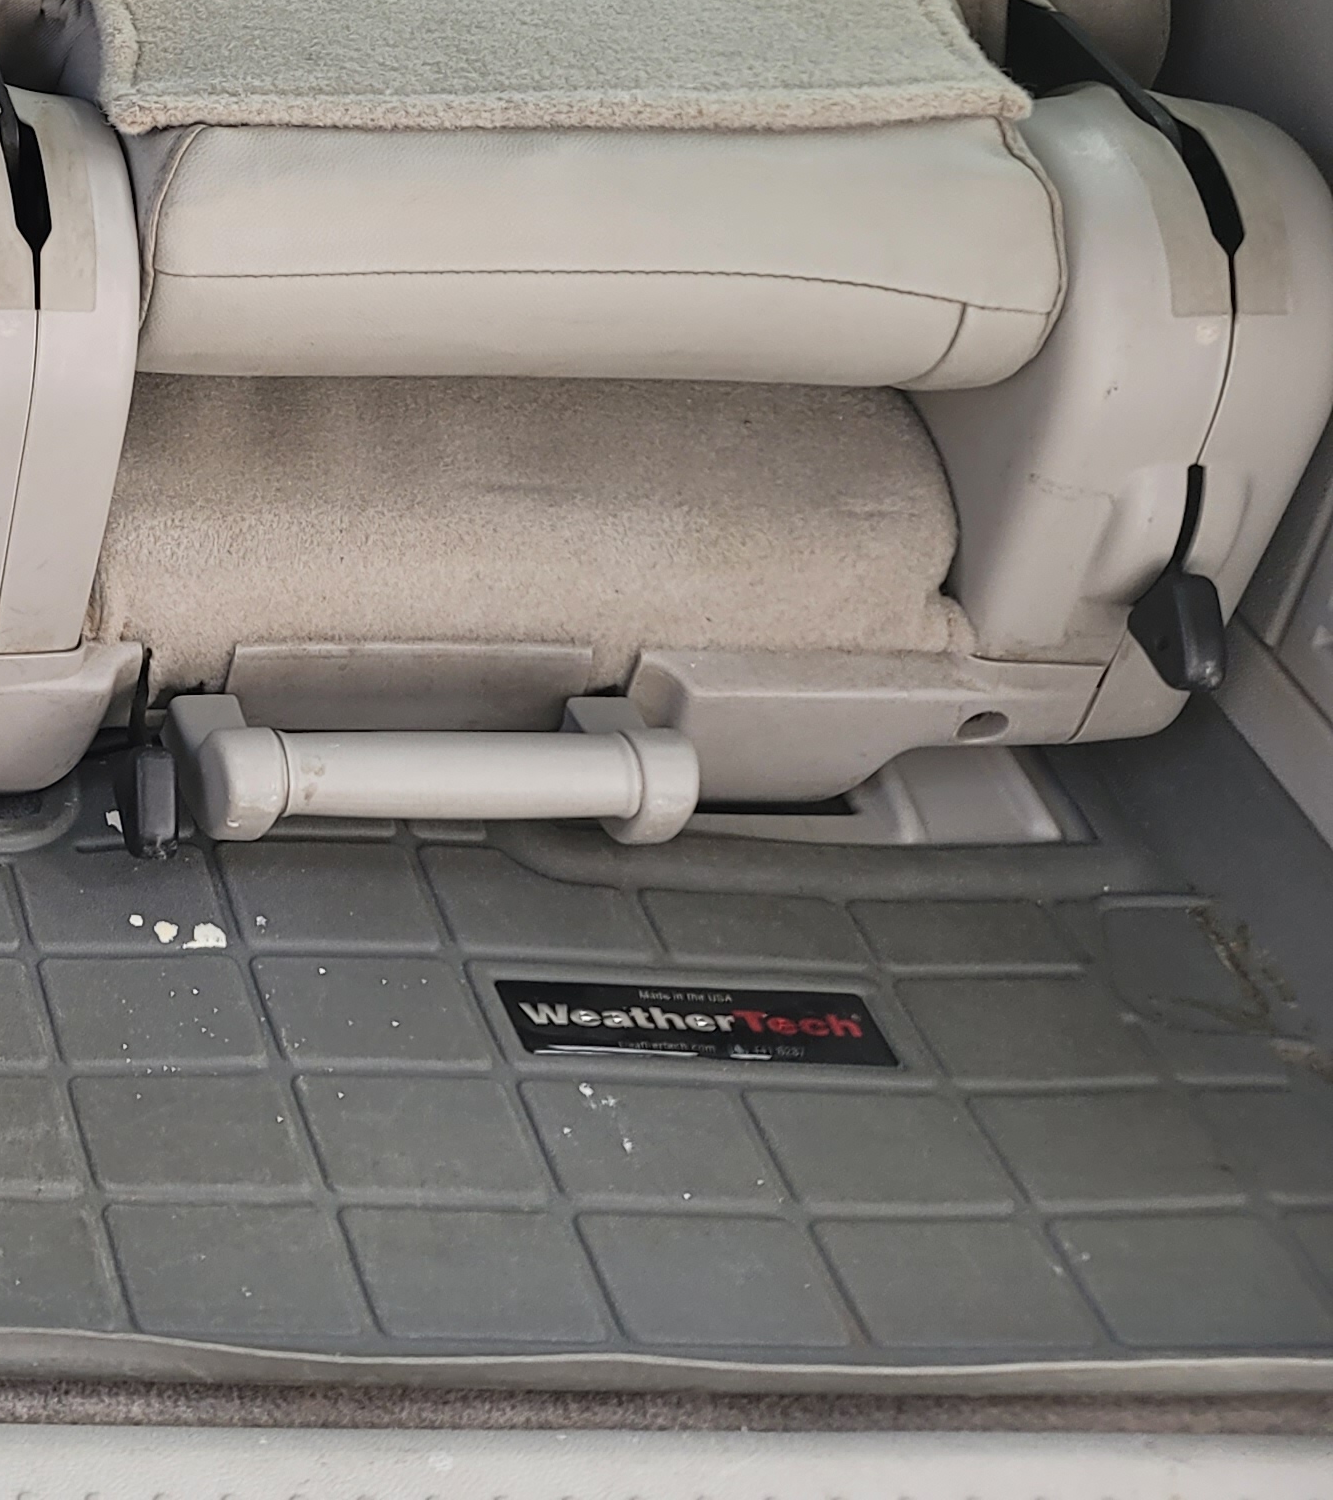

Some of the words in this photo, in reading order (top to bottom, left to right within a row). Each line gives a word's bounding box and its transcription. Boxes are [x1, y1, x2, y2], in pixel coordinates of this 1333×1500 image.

[638, 989, 671, 1001] Made
[686, 993, 704, 1002] the
[707, 993, 733, 1004] USA
